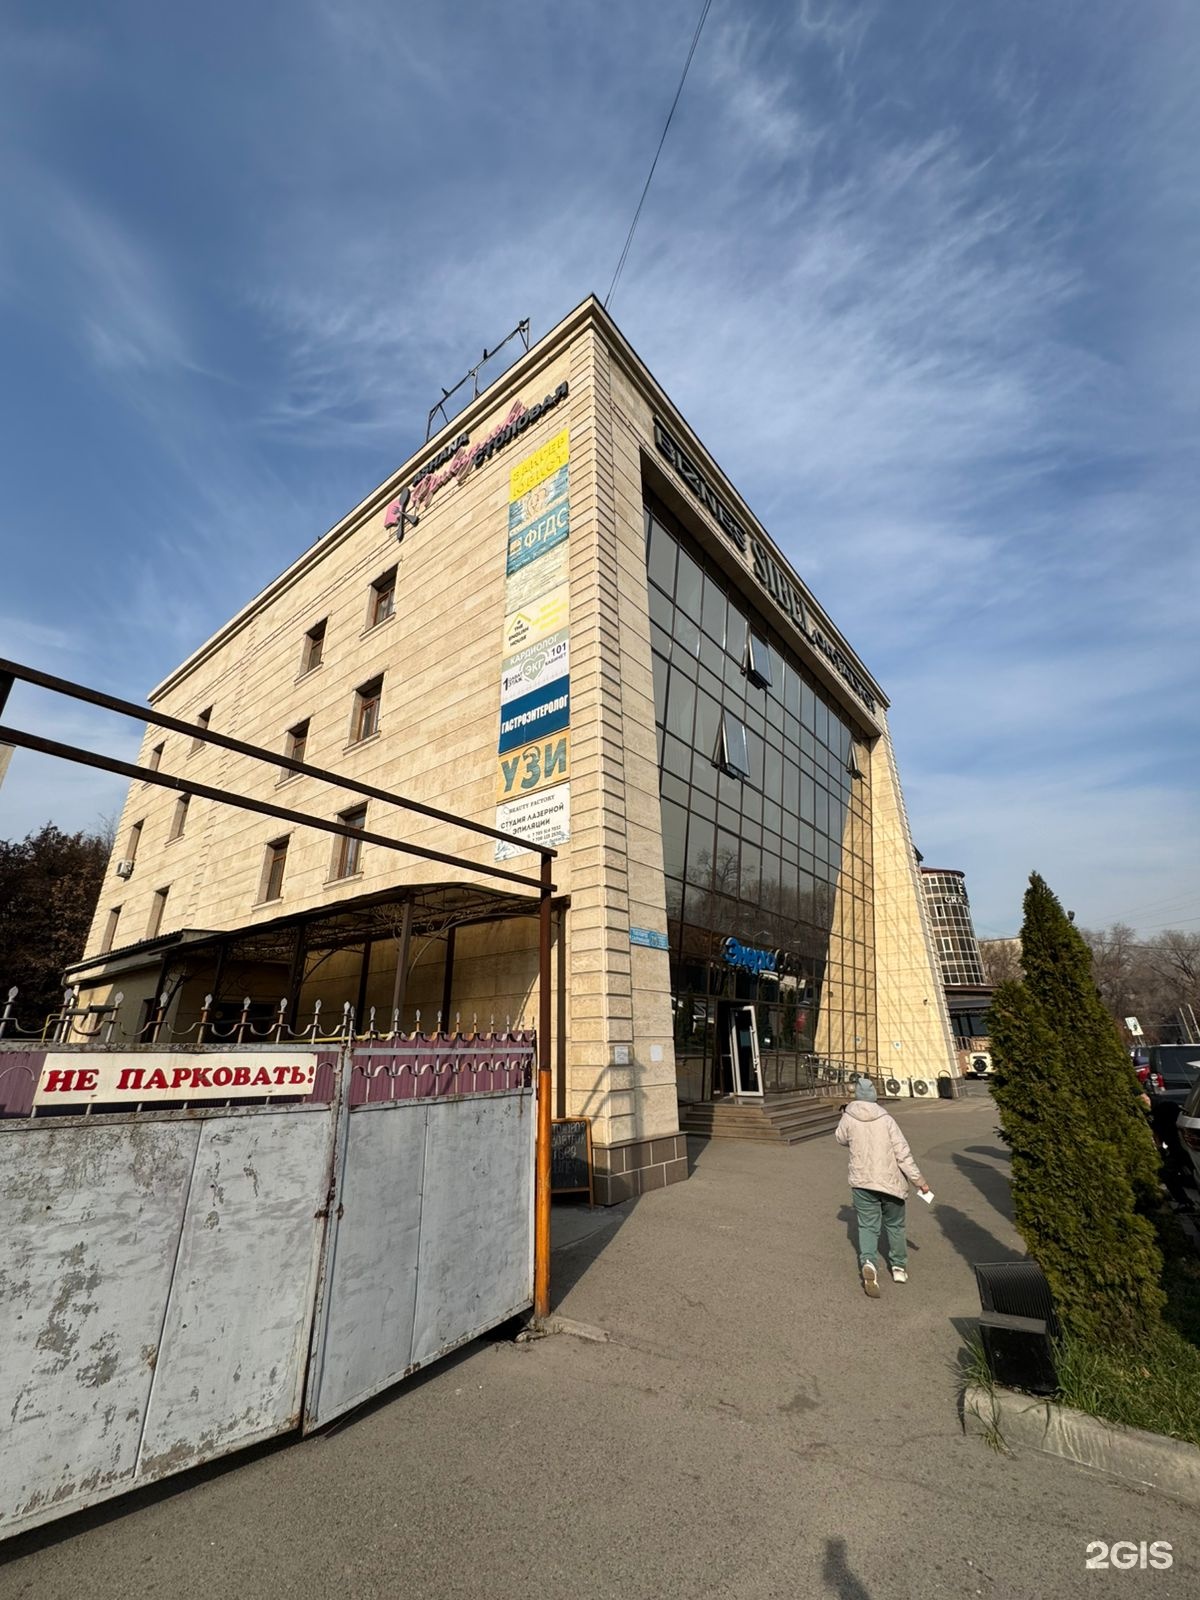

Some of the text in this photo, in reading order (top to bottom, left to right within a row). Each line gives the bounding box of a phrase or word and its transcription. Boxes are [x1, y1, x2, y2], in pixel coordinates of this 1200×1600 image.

[474, 381, 568, 467] СТОЛОВАЯ
[412, 432, 469, 485] ASHANA
[524, 507, 567, 548] ФГДС
[510, 634, 558, 665] КАРДИОЛОГ
[551, 643, 566, 656] 101
[525, 658, 543, 675] ЭКГ
[503, 678, 509, 691] 1
[501, 694, 568, 734] ГАСТРОЭНТЕРОЛОГ
[501, 737, 567, 793] УЗИ
[500, 802, 564, 829] СТУДИЯ ЛАЗЕРНОЙ
[509, 795, 555, 814] BEAUTY FACTORY
[512, 818, 550, 835] ЭПИЛЯЦИИ
[42, 1065, 315, 1092] НЕ ПАРКОВАТЬ!
